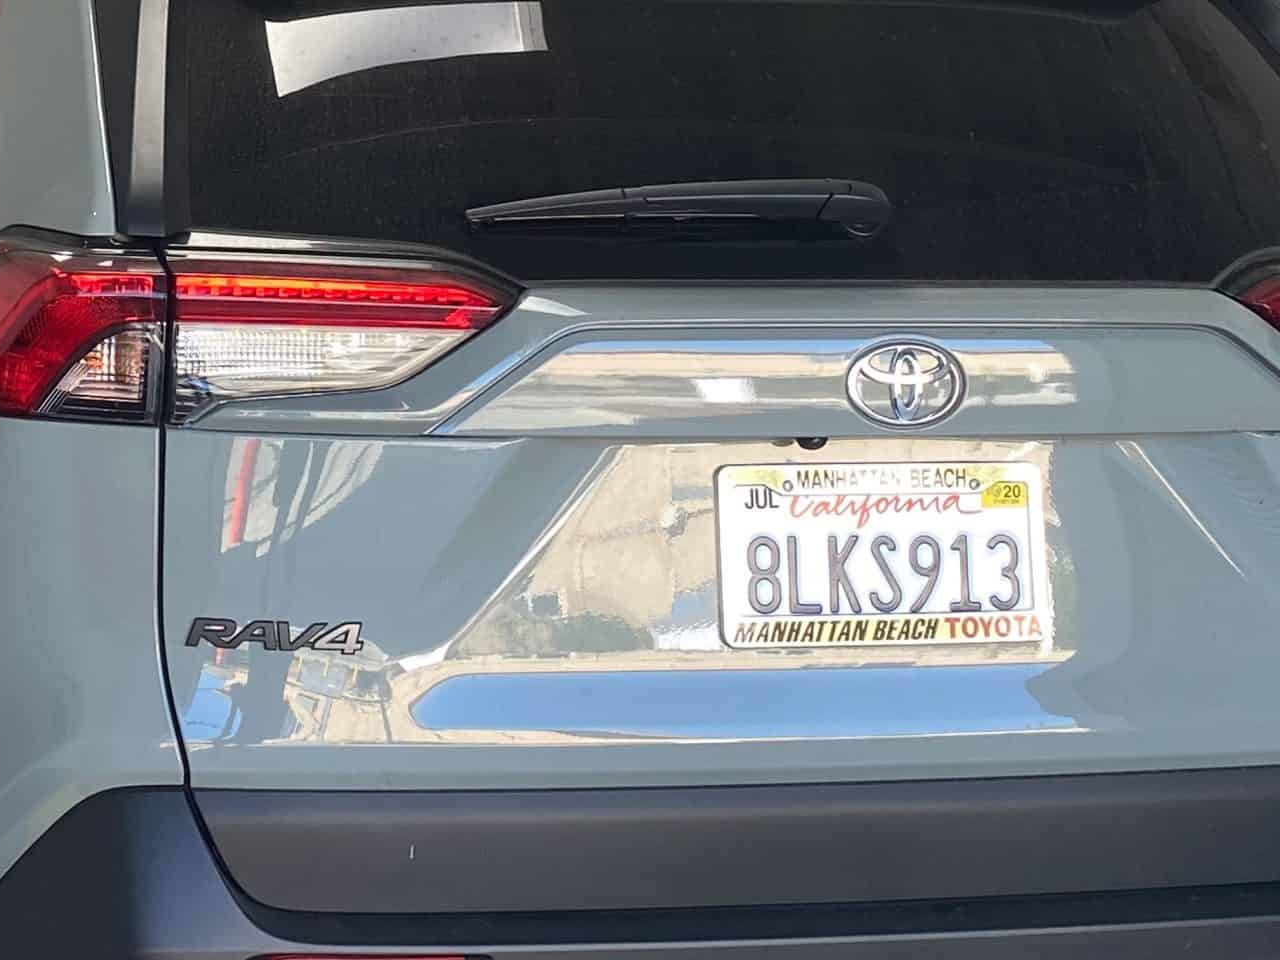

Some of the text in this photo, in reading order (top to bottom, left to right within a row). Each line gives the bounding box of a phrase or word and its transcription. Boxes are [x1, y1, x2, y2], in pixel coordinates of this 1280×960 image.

[911, 468, 968, 488] BEACH
[744, 484, 1022, 529] JUL California 20
[746, 533, 1022, 616] 8LKS913
[185, 617, 364, 655] RAV4
[734, 615, 1042, 643] MANHATTAN BEACH TOYOTA
